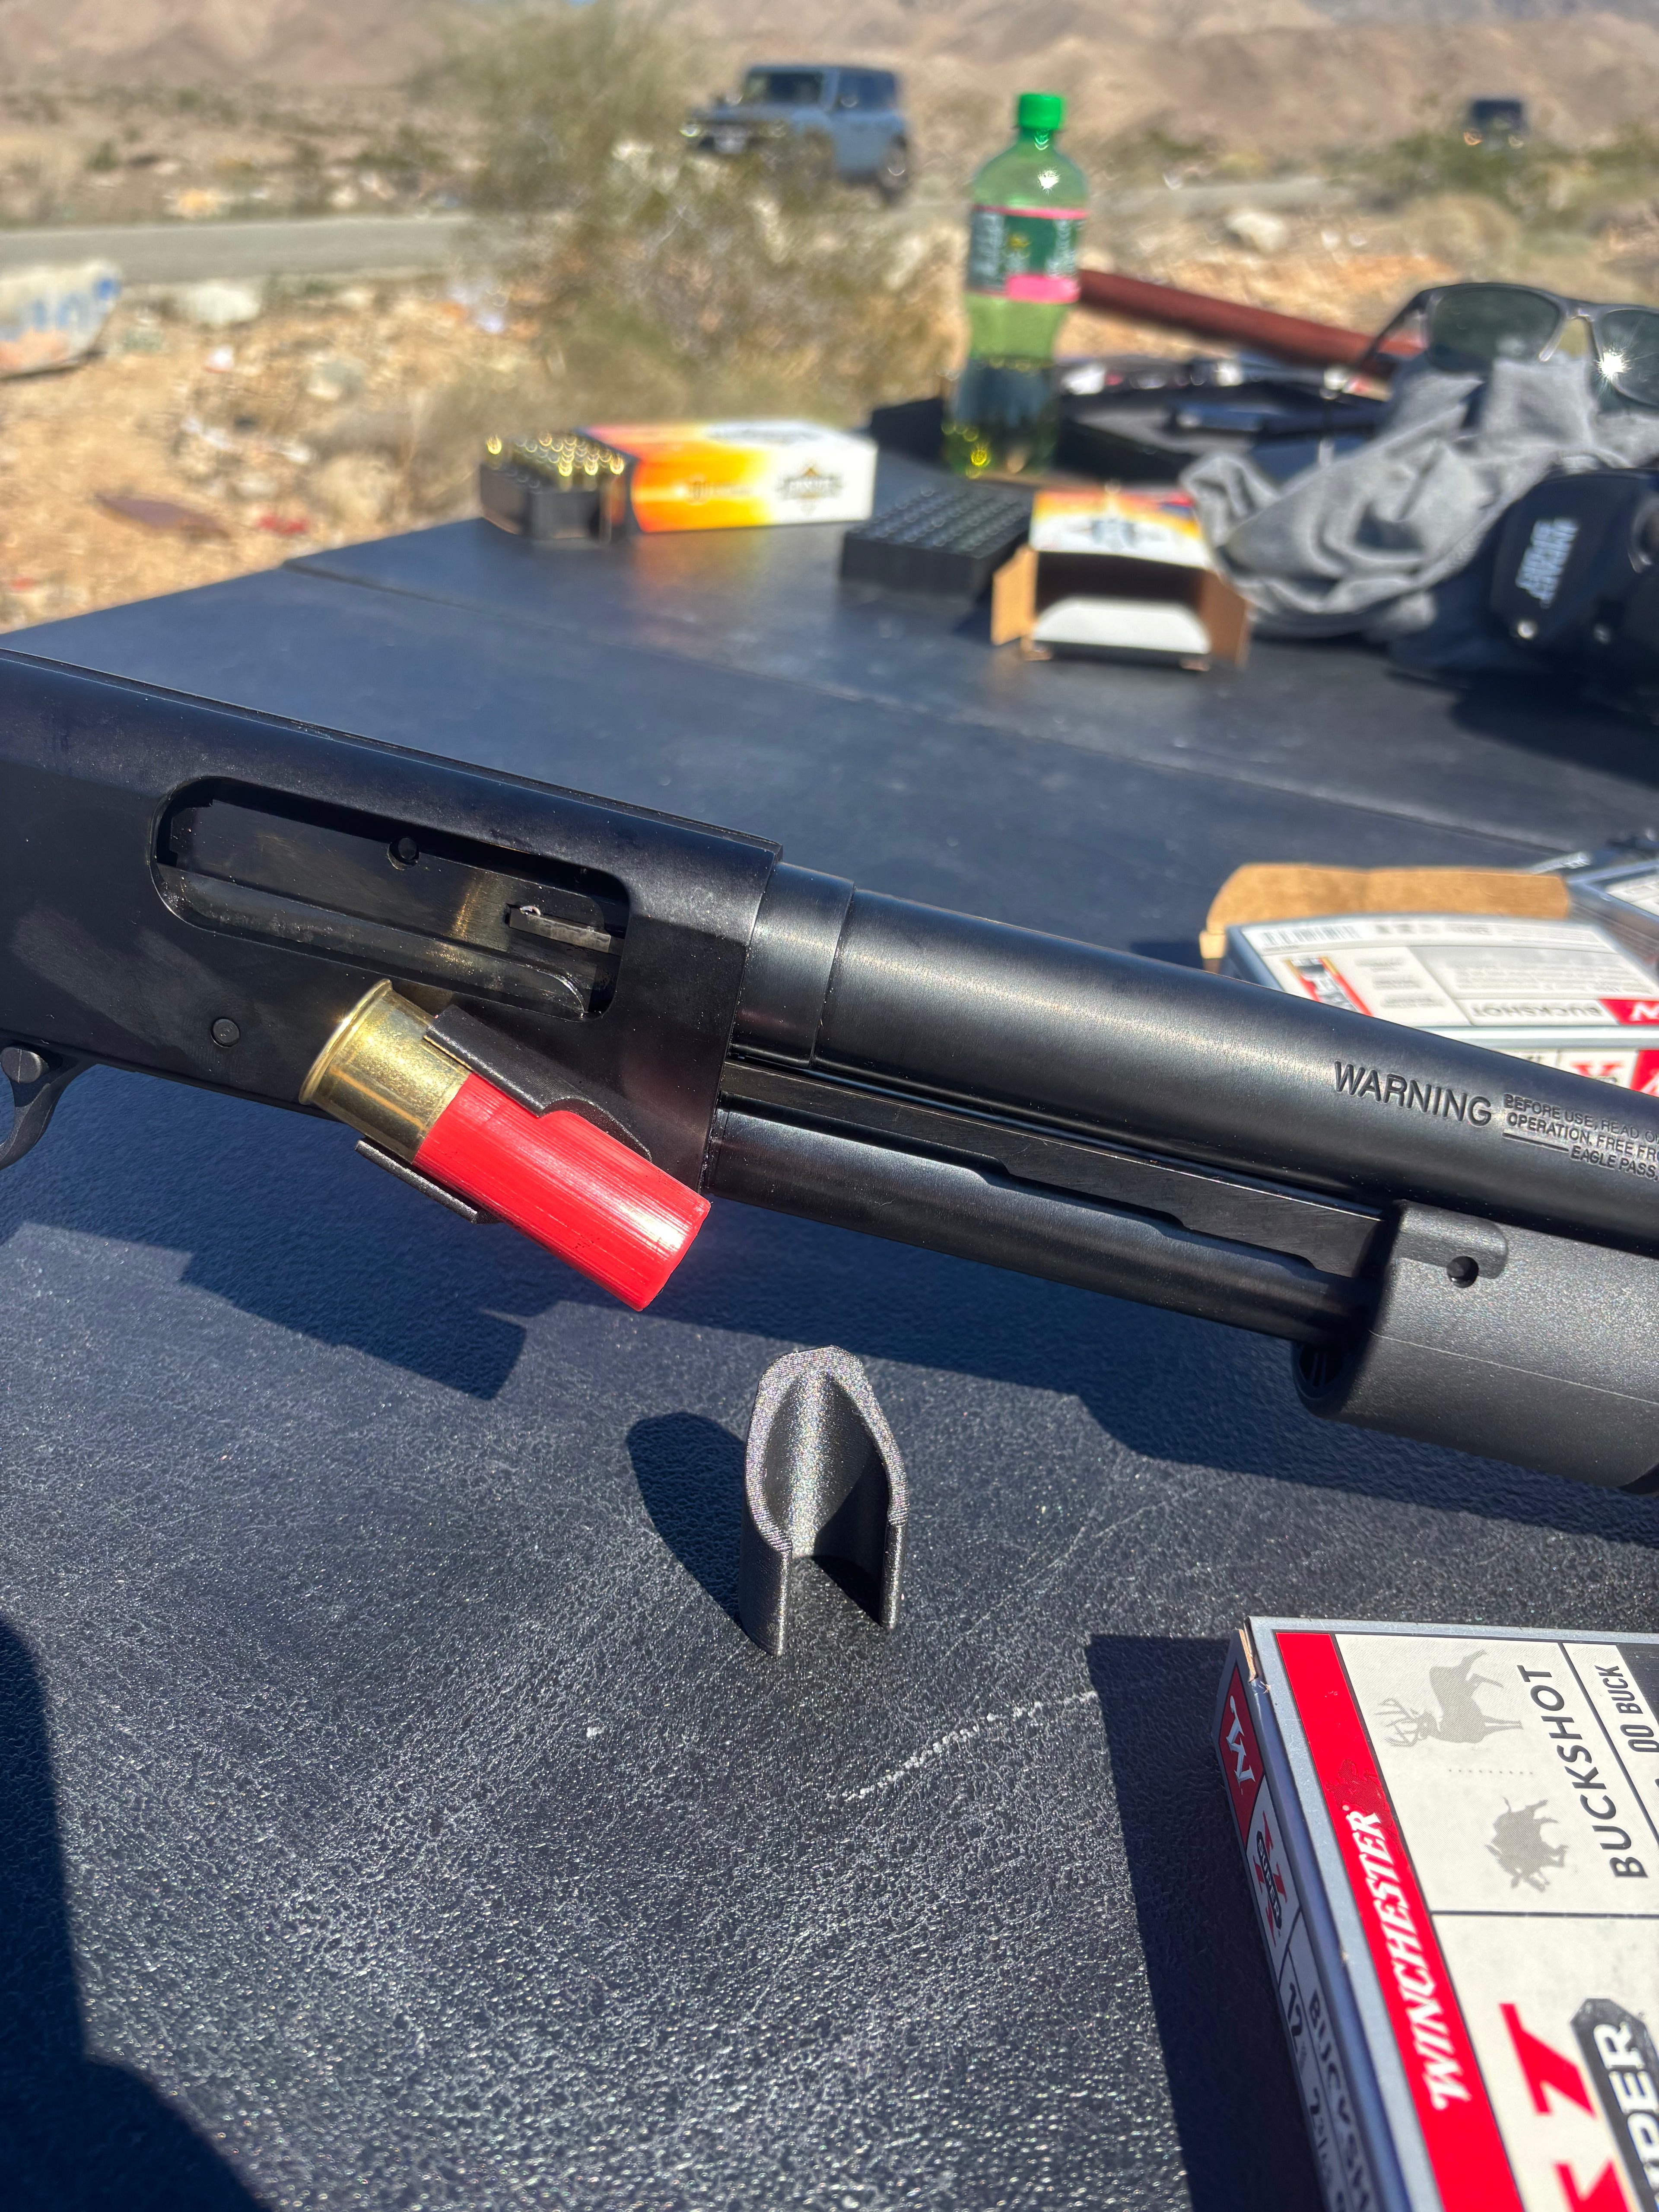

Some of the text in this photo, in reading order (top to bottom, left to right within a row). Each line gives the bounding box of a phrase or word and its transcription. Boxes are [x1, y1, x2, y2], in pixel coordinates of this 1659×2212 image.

[1334, 1060, 1492, 1128] WARNING
[1503, 1093, 1561, 1120] BEFORE
[1601, 1119, 1640, 1139] READ
[1506, 1112, 1592, 1146] OPERATION.
[1596, 1134, 1634, 1156] FREE
[1570, 1145, 1617, 1170] EAGLE
[1594, 1665, 1659, 1753] 00 BUCK
[1517, 1665, 1649, 1878] BUCKSHOT
[1258, 1839, 1279, 1916] SUPER
[1345, 1811, 1473, 2110] WINCHESTER
